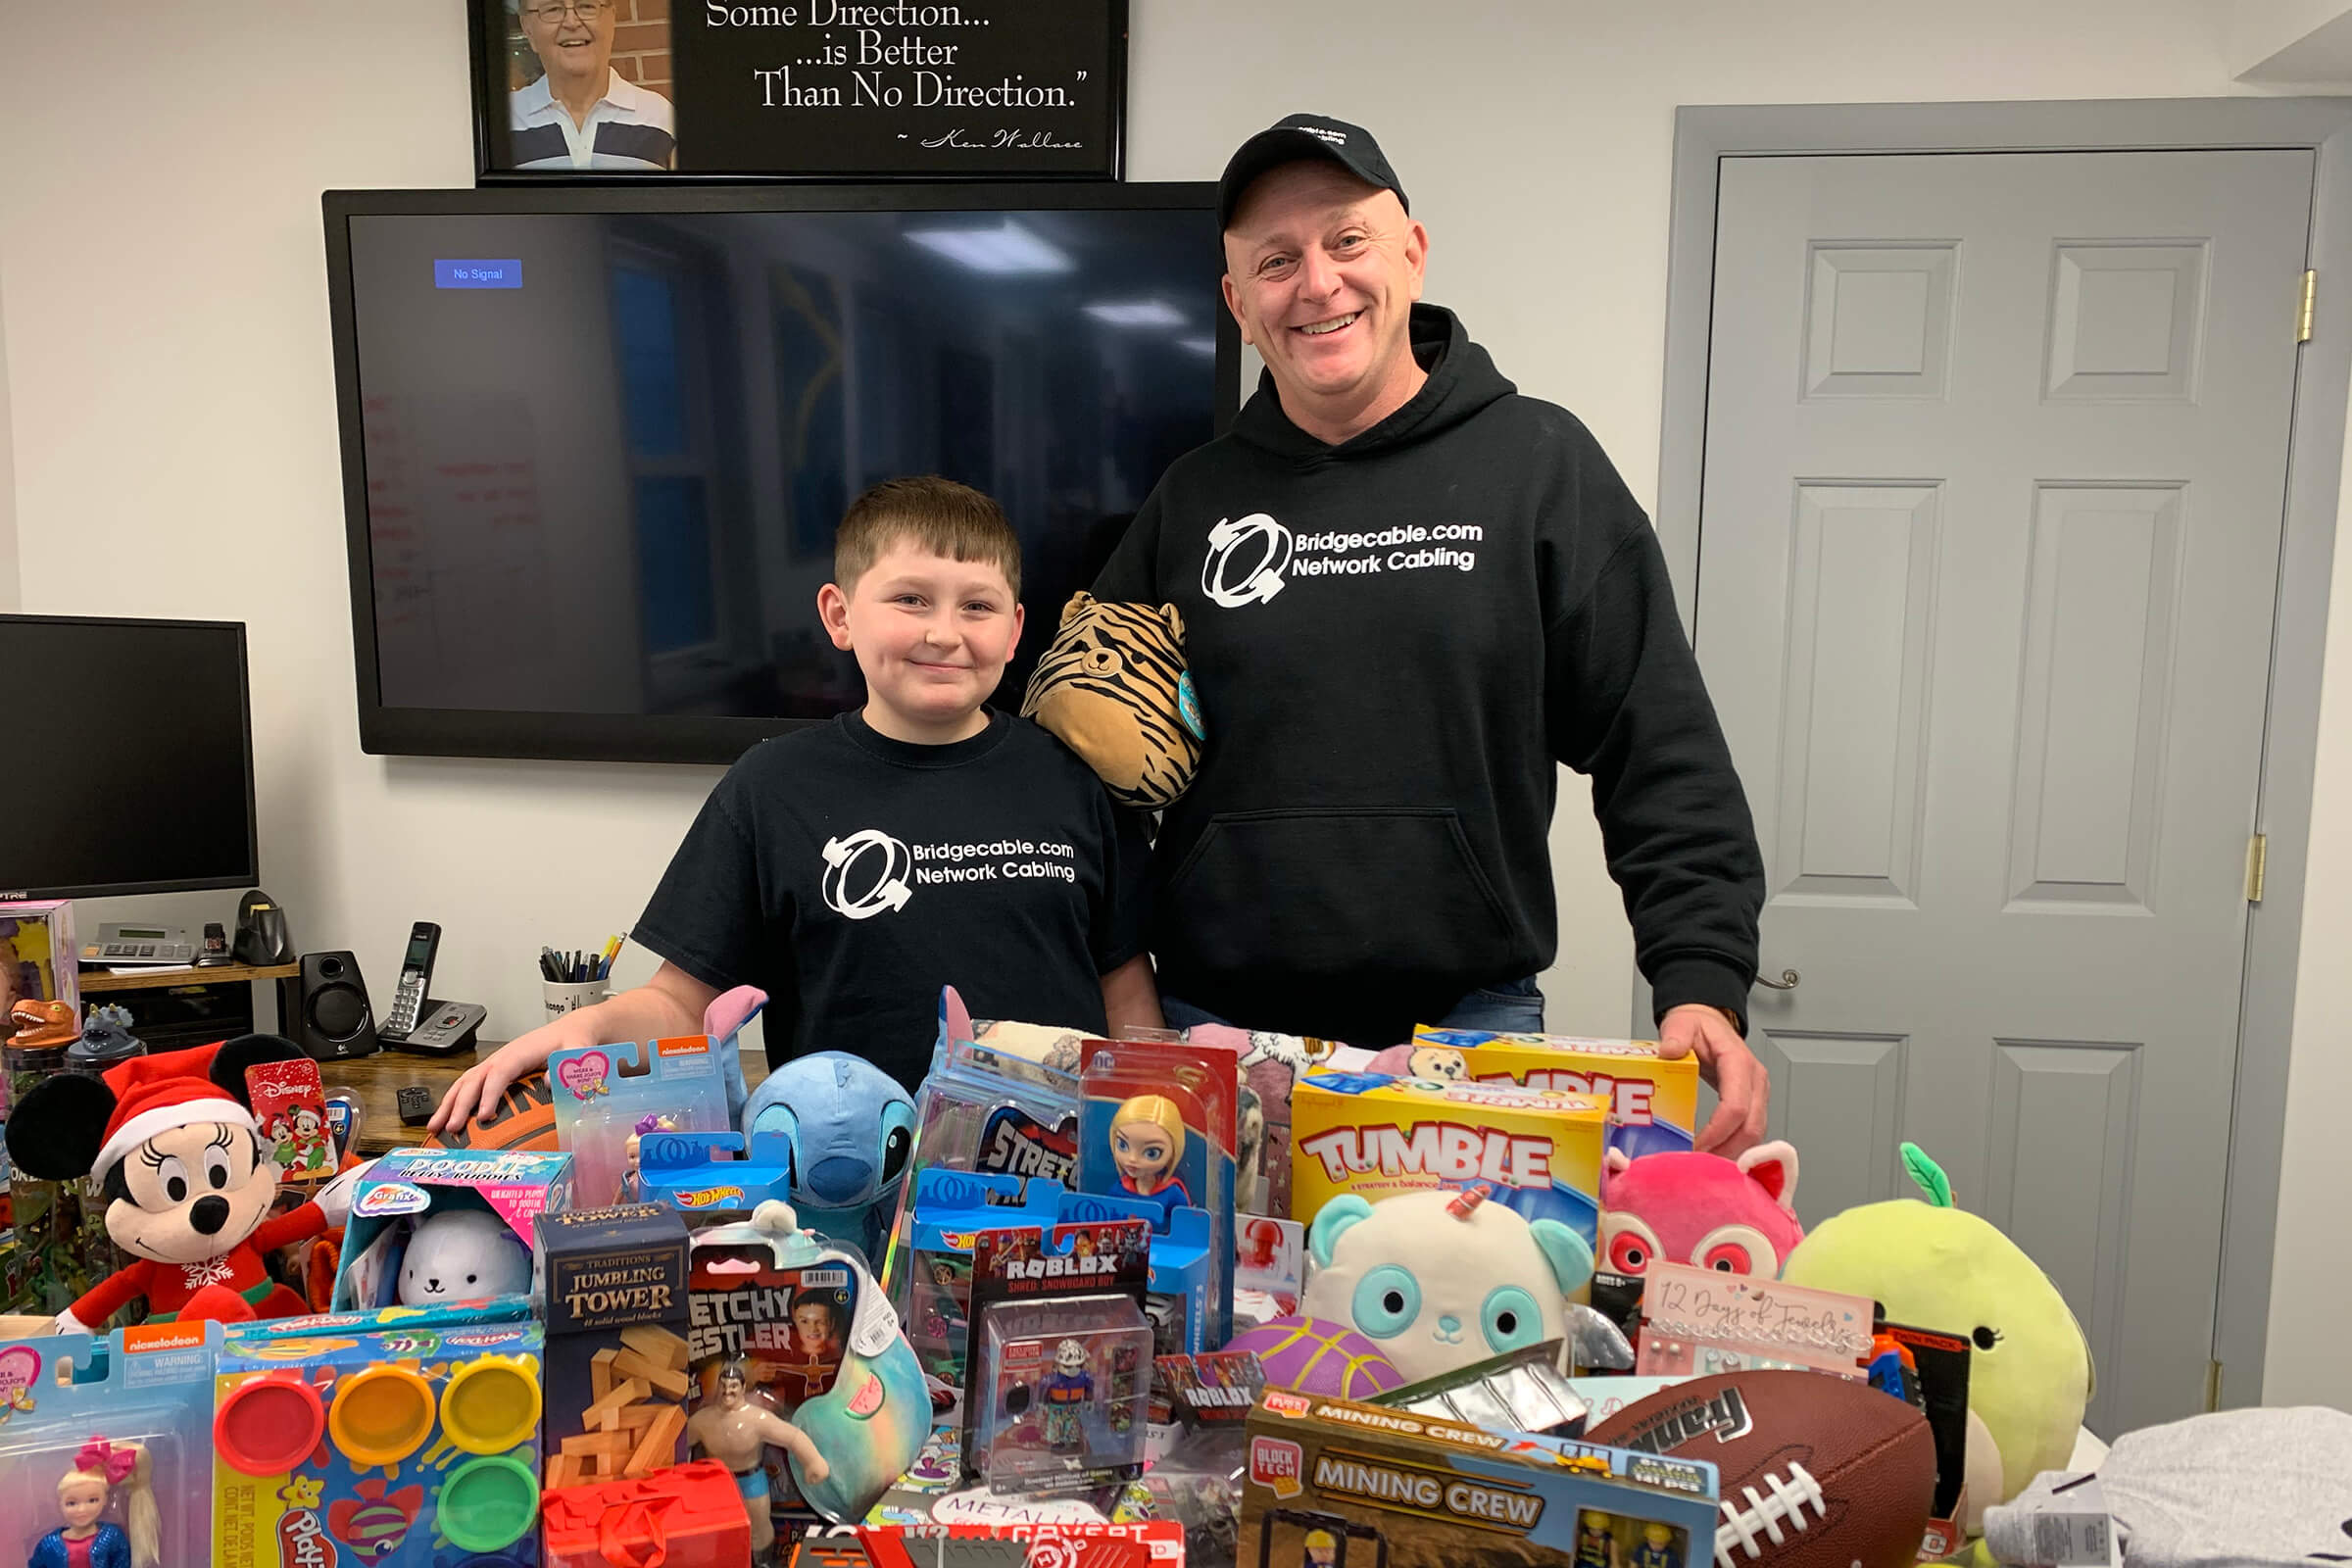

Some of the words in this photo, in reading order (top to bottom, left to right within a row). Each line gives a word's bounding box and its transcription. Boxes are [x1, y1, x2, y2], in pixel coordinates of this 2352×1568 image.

[706, 0, 798, 27] Some
[808, 0, 990, 26] Direction...
[857, 29, 958, 66] Better
[754, 66, 842, 107] Than
[851, 72, 903, 108] No
[920, 129, 986, 149] Ken
[991, 129, 1082, 149] Wallace
[454, 269, 468, 279] No
[471, 269, 503, 281] Signal
[1295, 524, 1483, 554] Bridgecable.com
[1292, 555, 1382, 576] Network
[1387, 548, 1475, 571] Cabling
[912, 839, 1074, 862] Bridgecable.com
[915, 863, 997, 884] Network
[1002, 861, 1075, 883] Cabling
[662, 1046, 706, 1055] nickelodeon
[1298, 1120, 1553, 1191] TUMBLE
[373, 1190, 412, 1201] Grafix
[691, 1193, 712, 1206] HOT
[711, 1187, 741, 1202] WHEELS
[586, 1254, 652, 1269] TRADITIONS
[1007, 1254, 1118, 1280] ROBLOX
[569, 1266, 665, 1294] JUMBLING
[564, 1284, 673, 1319] TOWER
[688, 1287, 793, 1326] ETCHY
[1661, 1281, 1688, 1313] 12
[1693, 1290, 1745, 1324] Days
[1749, 1295, 1774, 1323] of
[129, 1336, 199, 1350] nickelodeon
[688, 1322, 793, 1361] ESTLER
[1185, 1386, 1254, 1407] ROBLOX
[1316, 1404, 1423, 1434] MINING
[1426, 1425, 1507, 1448] CREW
[1256, 1447, 1294, 1464] BLOCK
[1258, 1462, 1295, 1476] TECH
[1316, 1459, 1442, 1506] MINING
[1447, 1484, 1540, 1525] CREW
[285, 1510, 324, 1568] Play-
